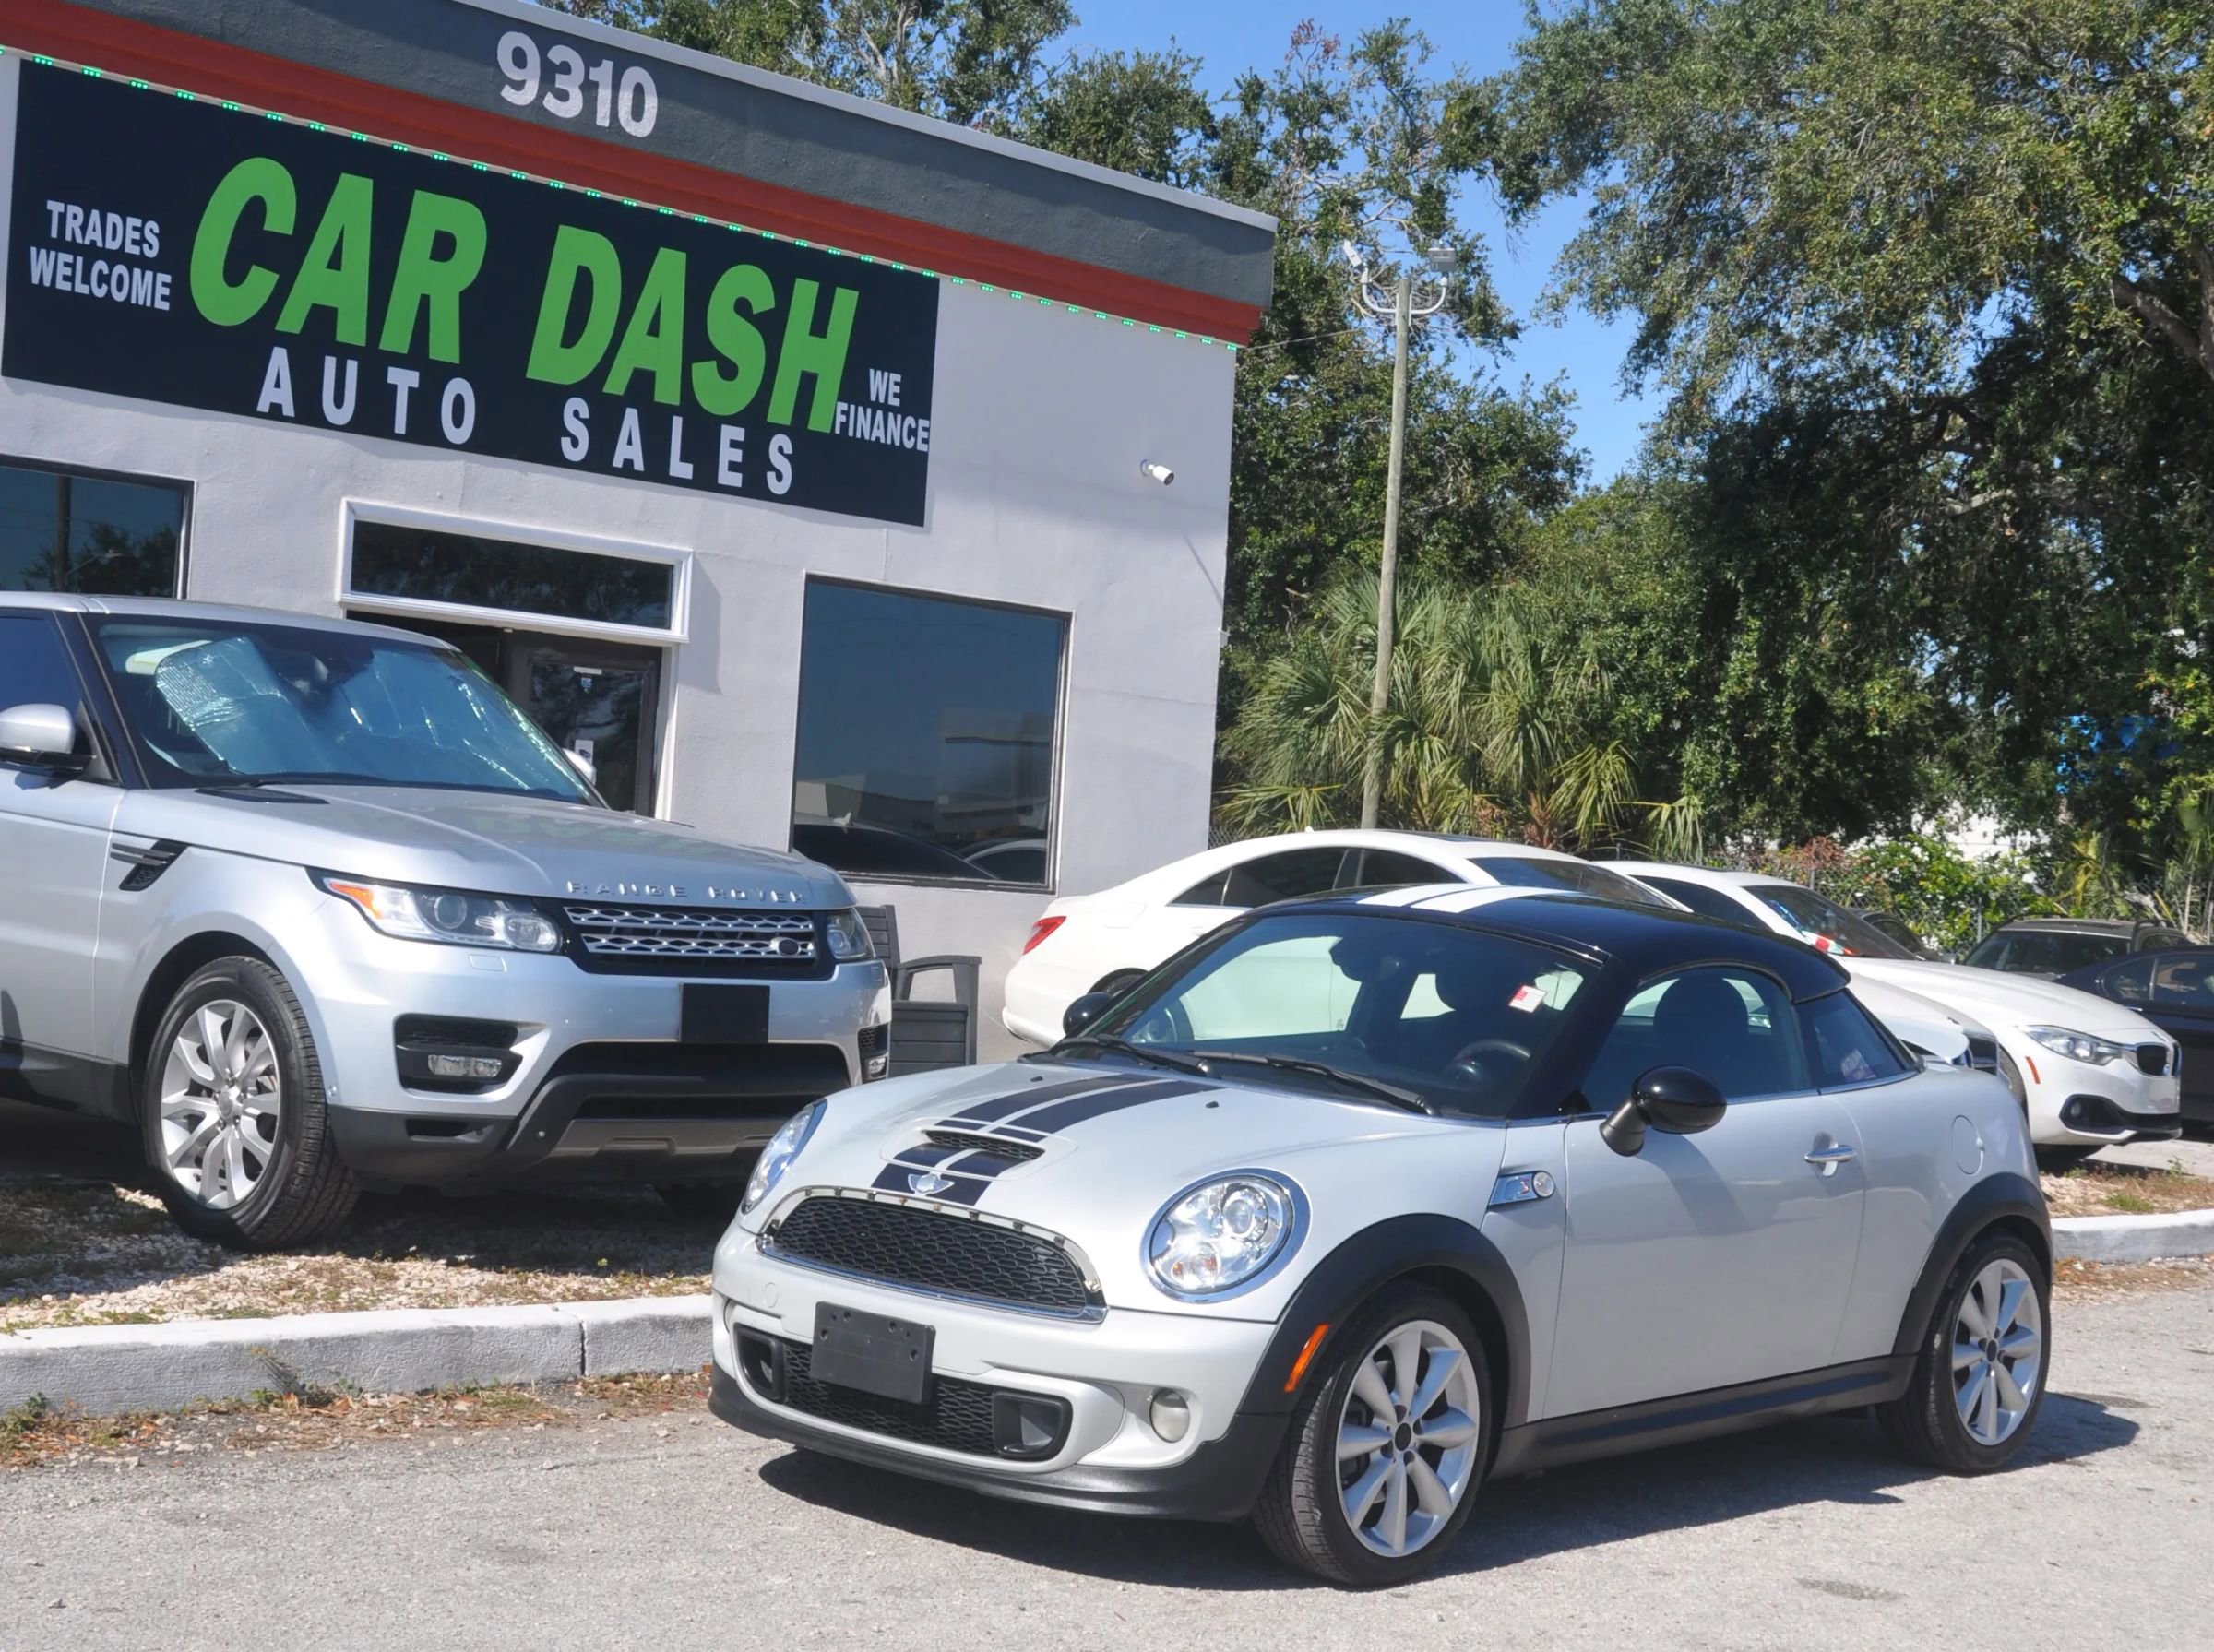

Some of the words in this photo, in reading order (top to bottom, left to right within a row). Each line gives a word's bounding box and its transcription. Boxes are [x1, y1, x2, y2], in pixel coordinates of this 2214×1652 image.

[496, 31, 659, 138] 9310
[46, 200, 161, 258] TRADES
[30, 246, 173, 312] WELCOME
[190, 157, 487, 364] CAR
[526, 225, 859, 434] DASH
[869, 368, 902, 408] WE
[256, 346, 477, 446] AUTO
[560, 397, 793, 496] SALES
[834, 401, 931, 452] FINANCE
[566, 880, 688, 897] RANGE
[708, 885, 806, 904] ROVER
